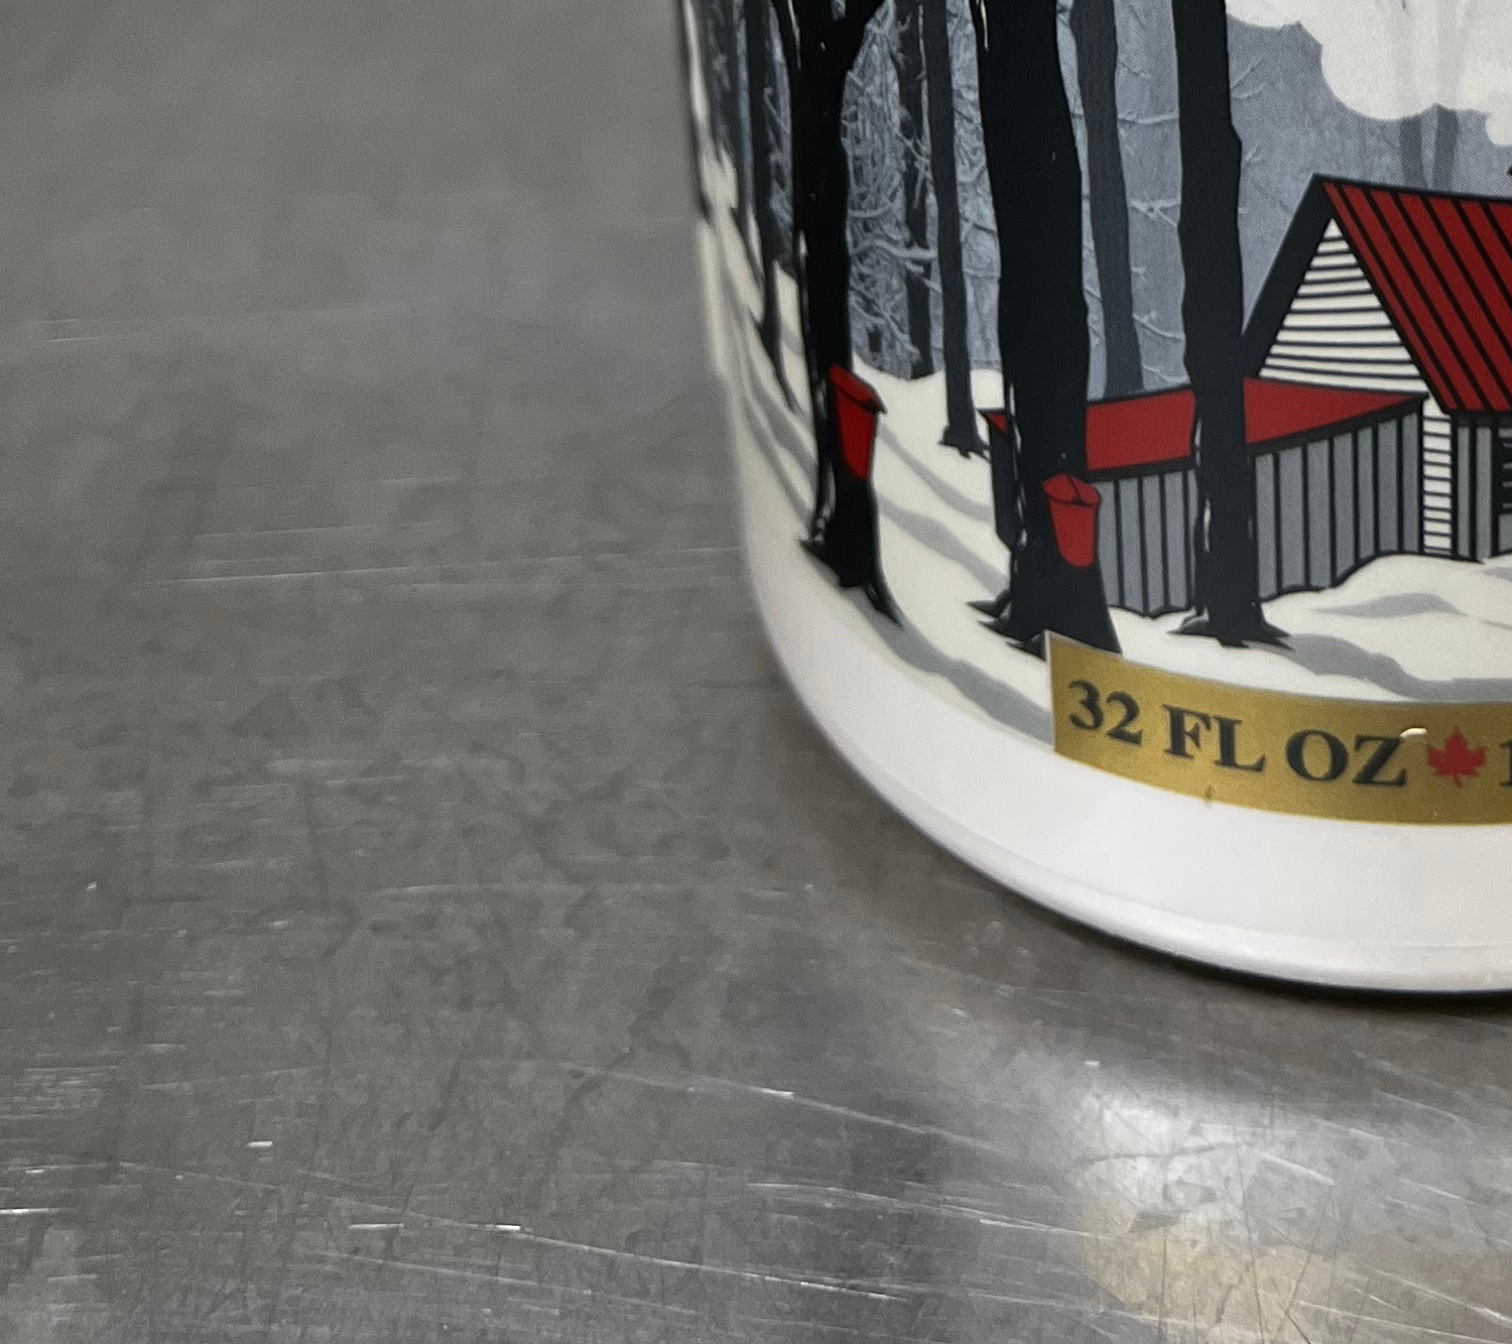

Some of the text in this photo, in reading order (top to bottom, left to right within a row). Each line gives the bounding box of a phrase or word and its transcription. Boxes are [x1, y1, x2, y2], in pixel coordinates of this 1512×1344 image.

[1068, 679, 1142, 746] 32
[1163, 704, 1266, 773] FL
[1286, 729, 1409, 787] OZ
